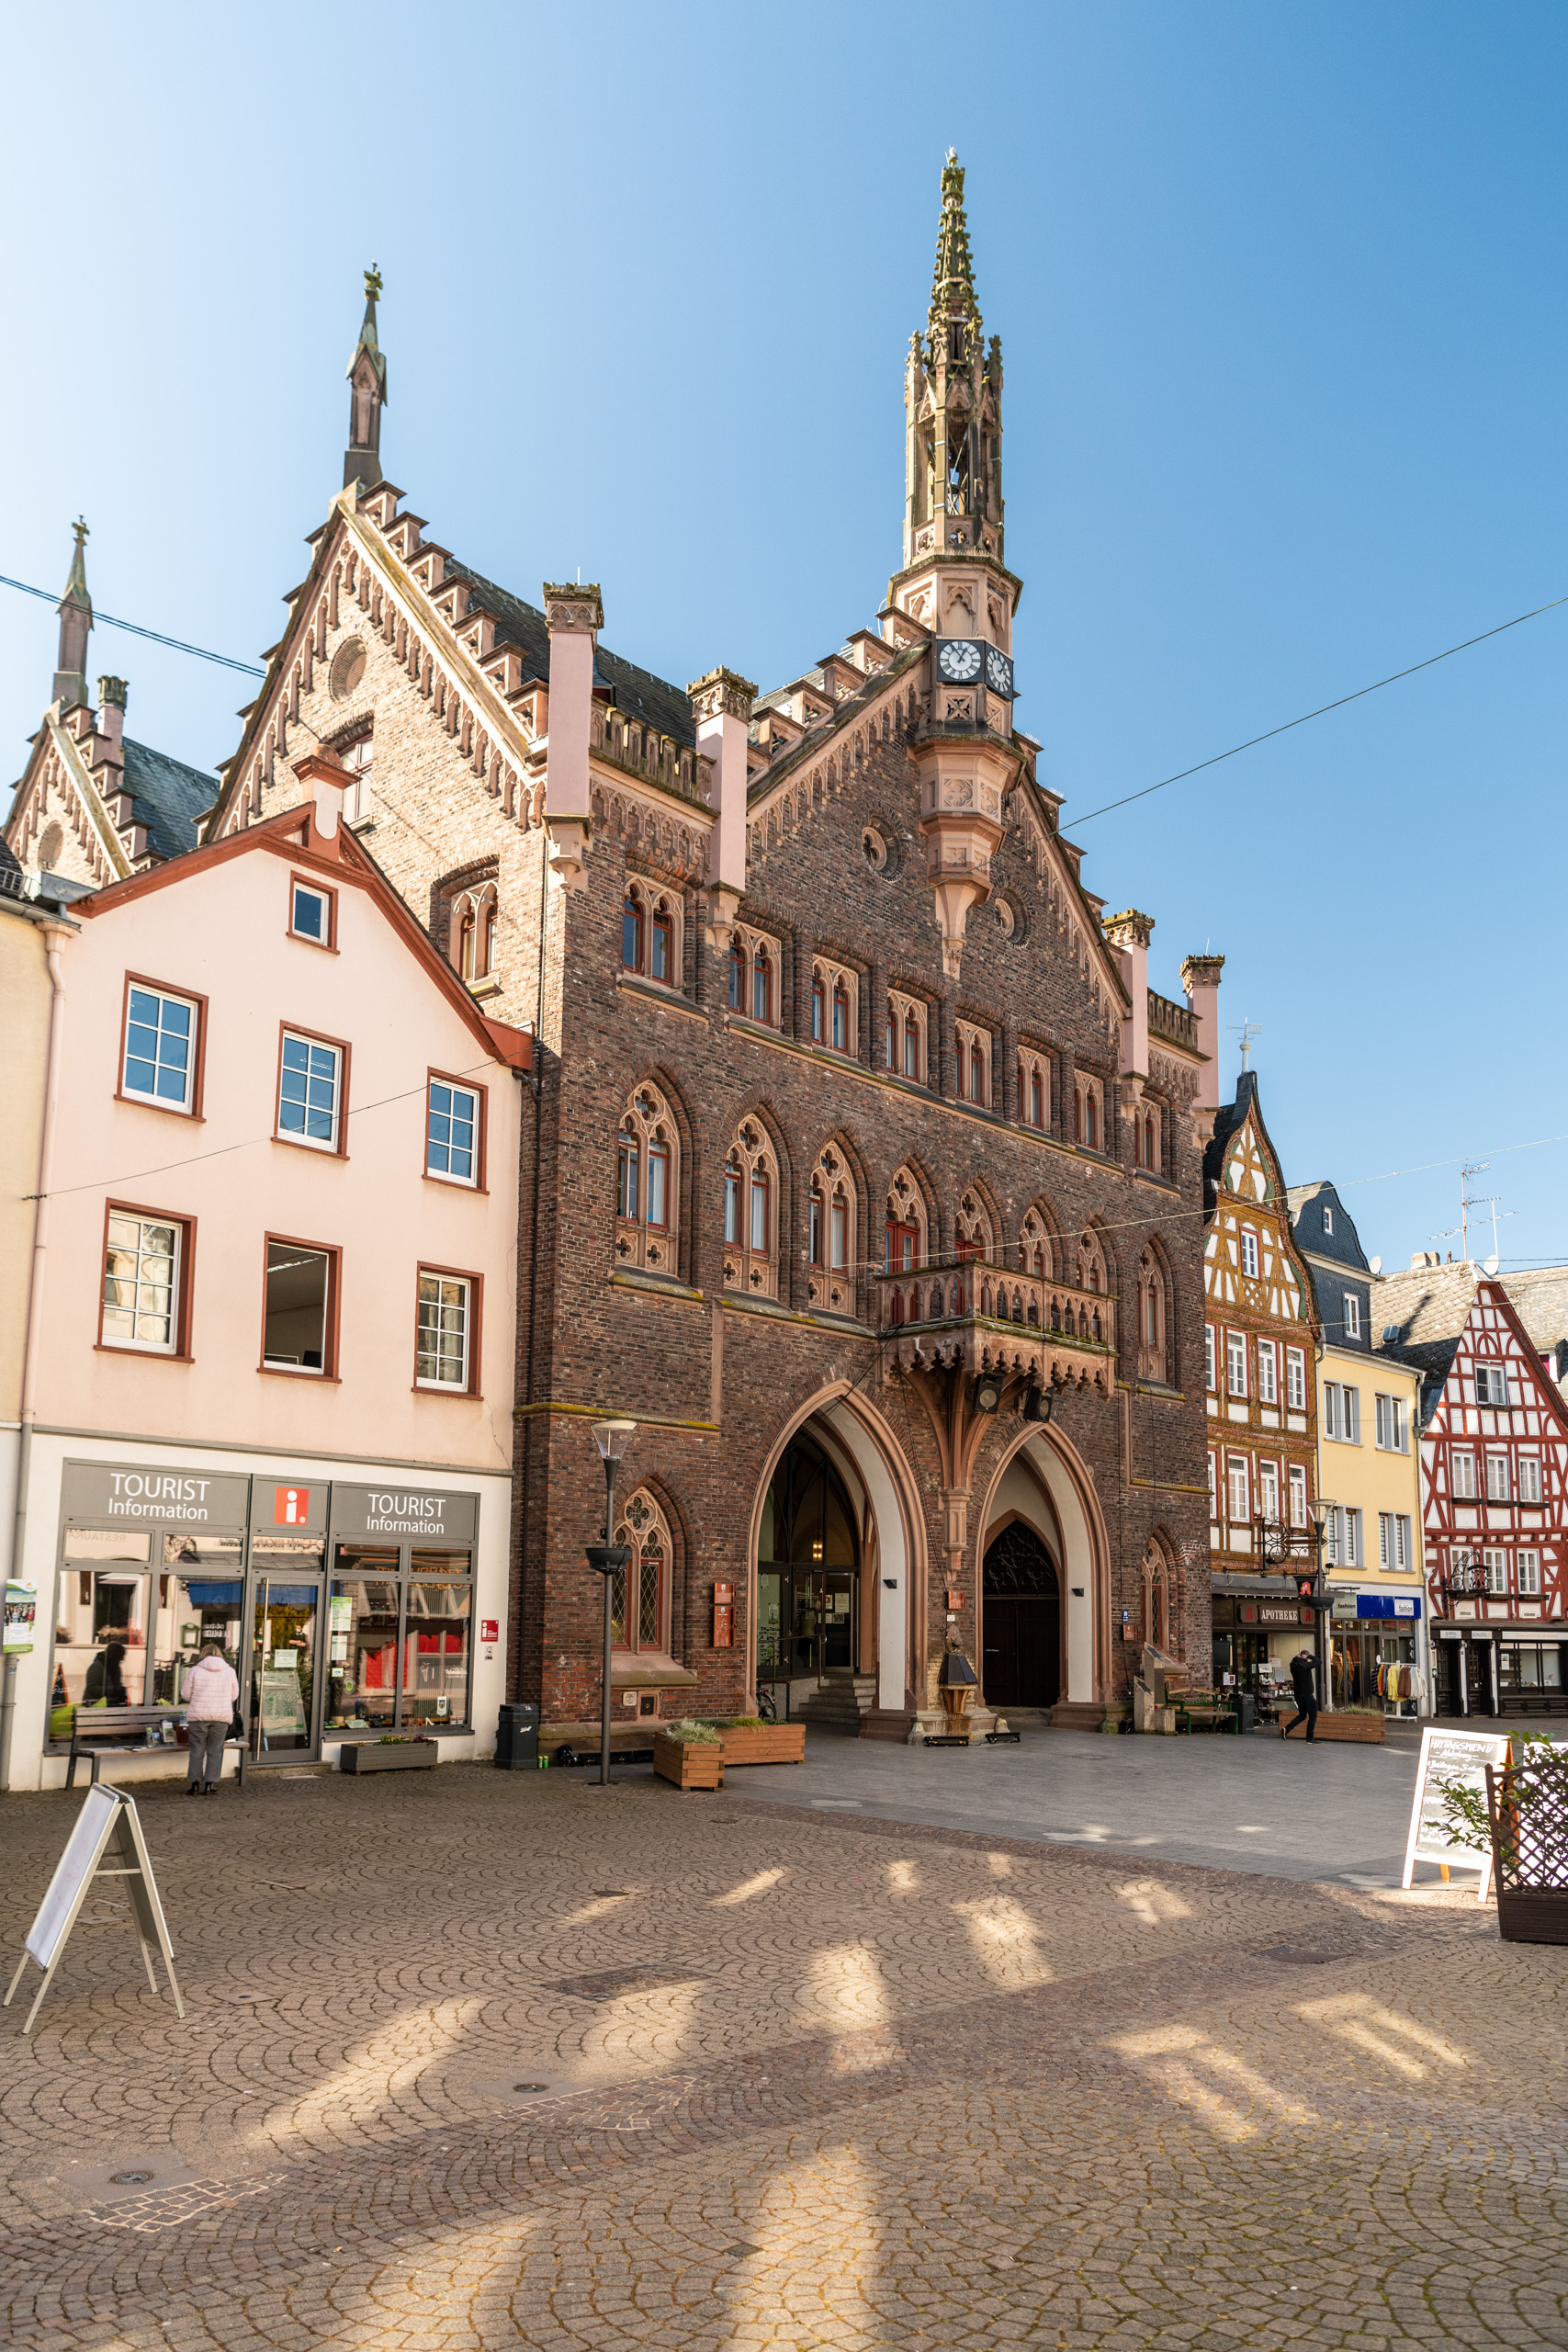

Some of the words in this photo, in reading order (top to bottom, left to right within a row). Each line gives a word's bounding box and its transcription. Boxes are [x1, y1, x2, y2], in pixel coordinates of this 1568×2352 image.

[110, 1473, 210, 1502] TOURIST
[108, 1498, 209, 1521] Information
[367, 1493, 446, 1518] TOURIST
[367, 1515, 445, 1534] Information
[1261, 1609, 1298, 1621] APOTHEKE
